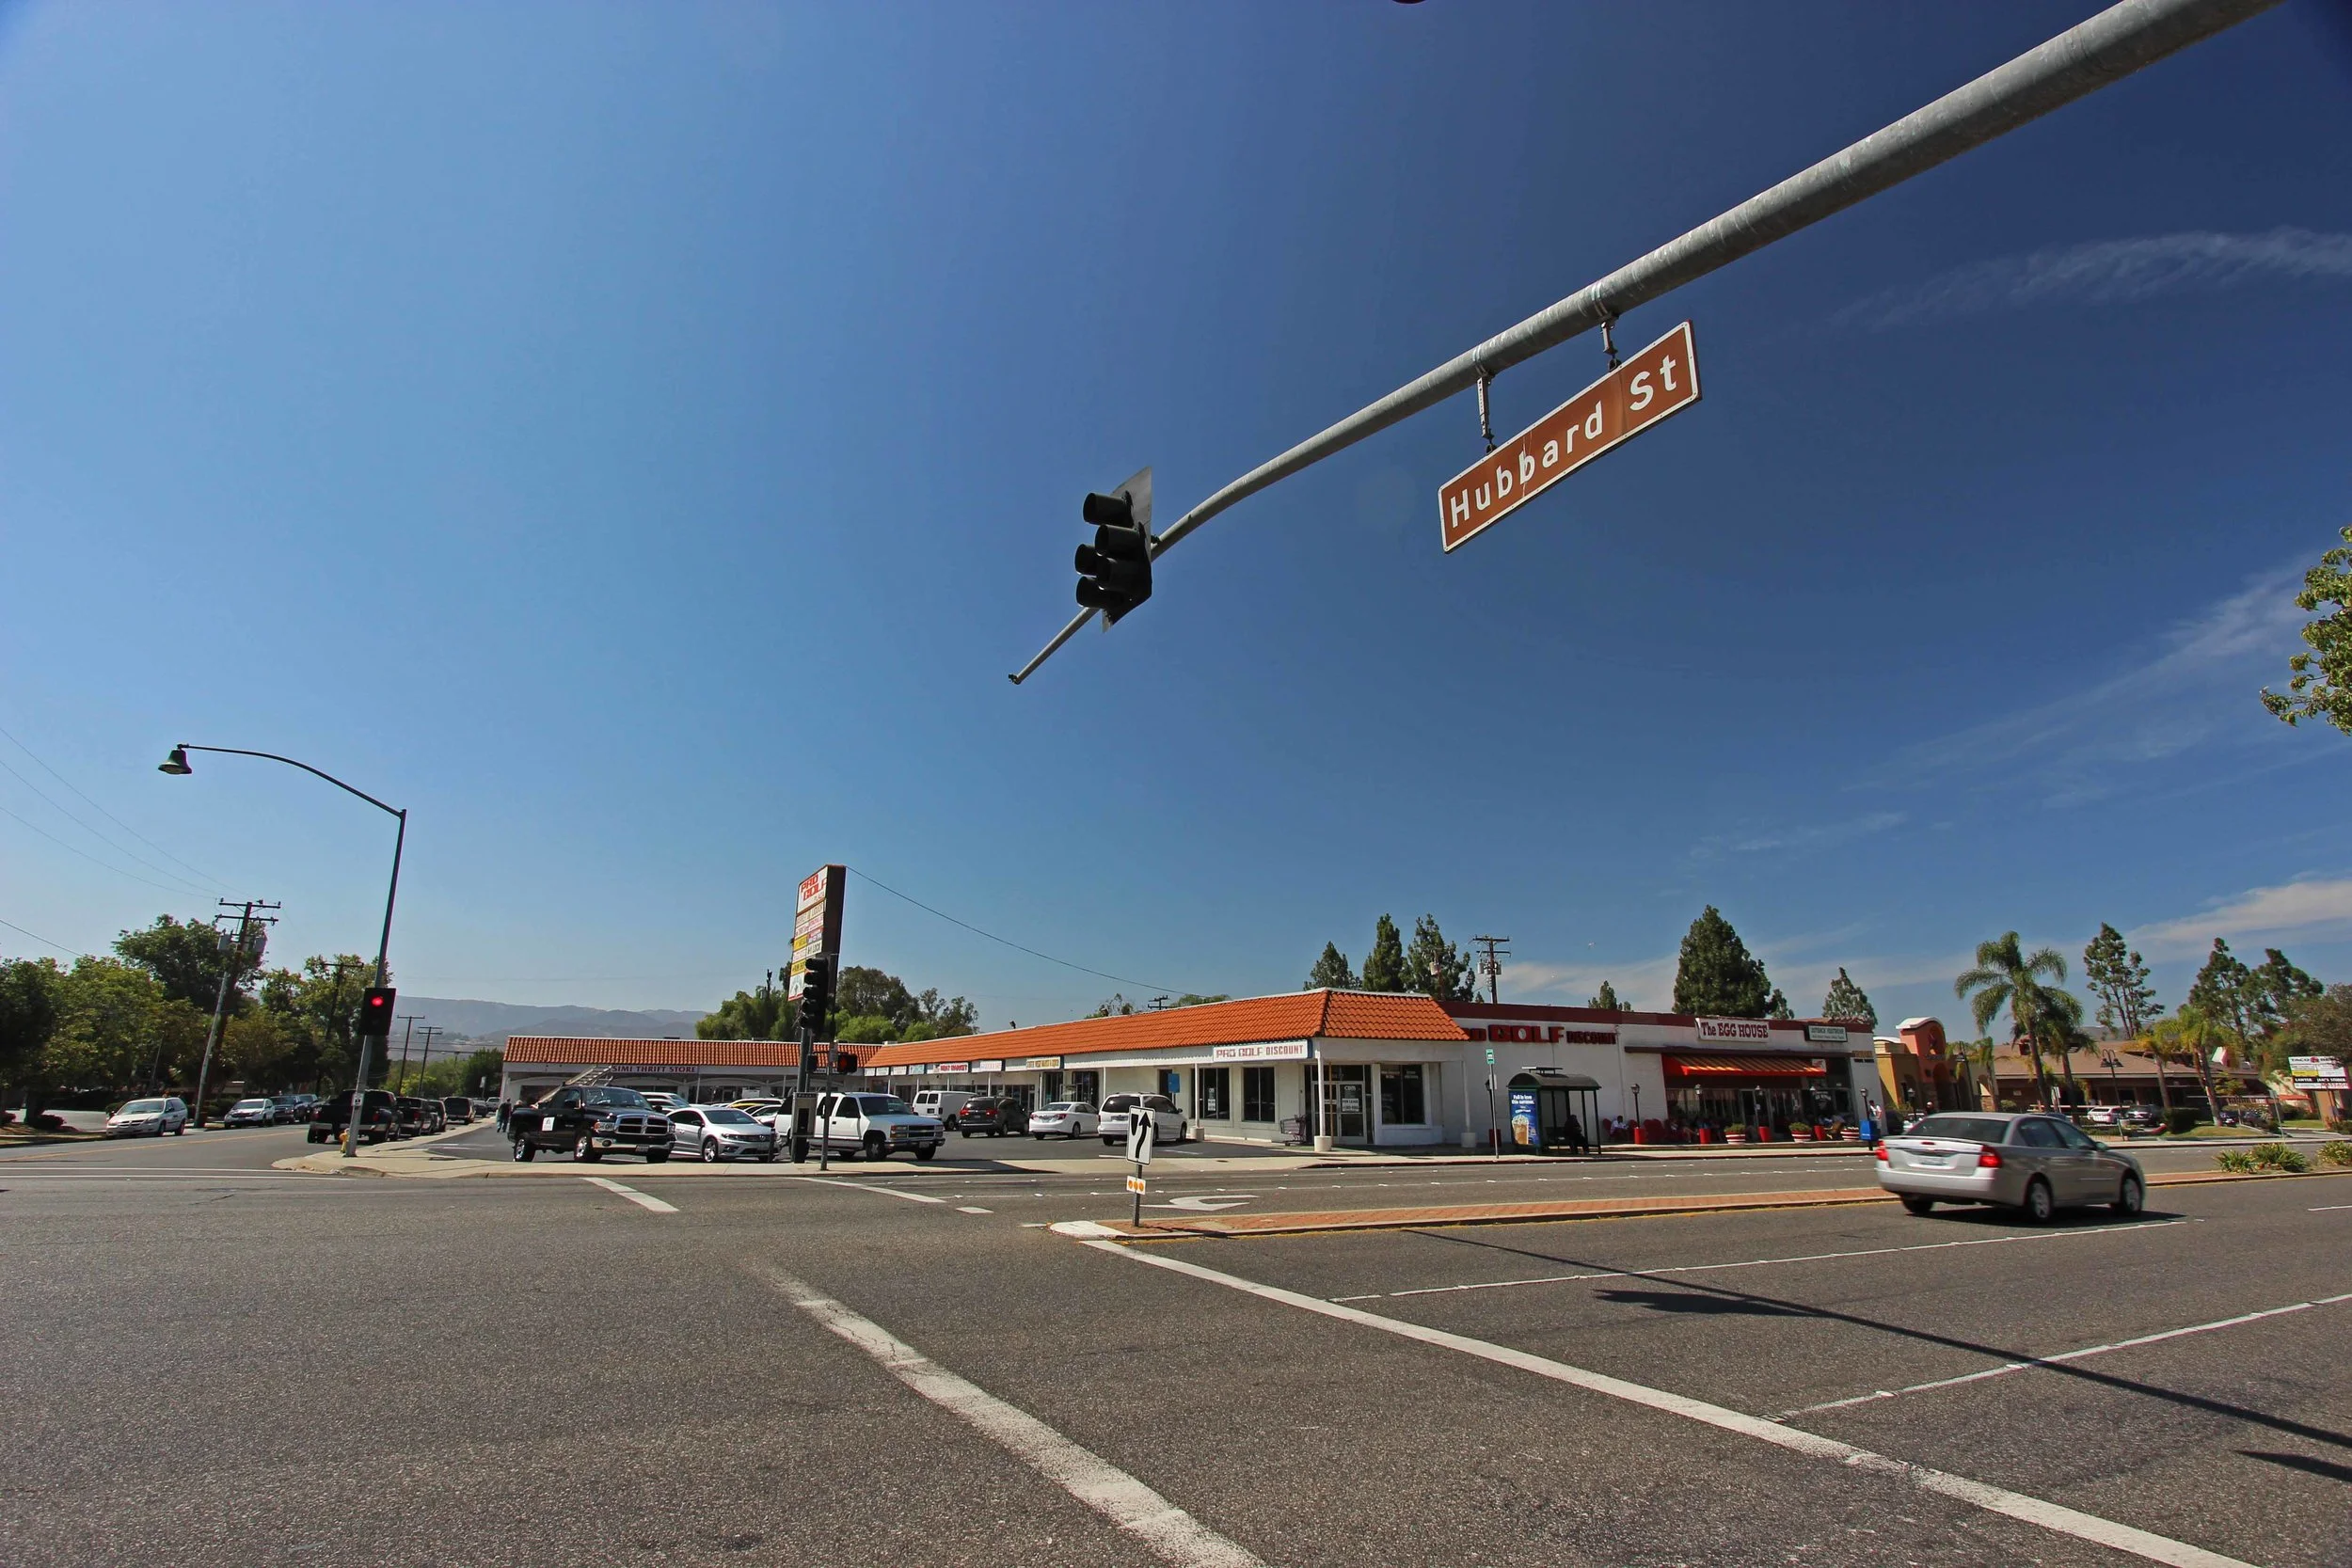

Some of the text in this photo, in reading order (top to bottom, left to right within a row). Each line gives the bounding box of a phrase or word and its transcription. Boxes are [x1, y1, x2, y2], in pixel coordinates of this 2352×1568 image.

[1450, 354, 1677, 529] Hubbard St
[801, 874, 818, 893] PRO
[803, 879, 827, 901] GOLF
[1487, 1024, 1565, 1043] GOLF
[1700, 1022, 1769, 1038] The EGG HOUSE
[1216, 1044, 1304, 1058] PRO GOLF DISCOUNT
